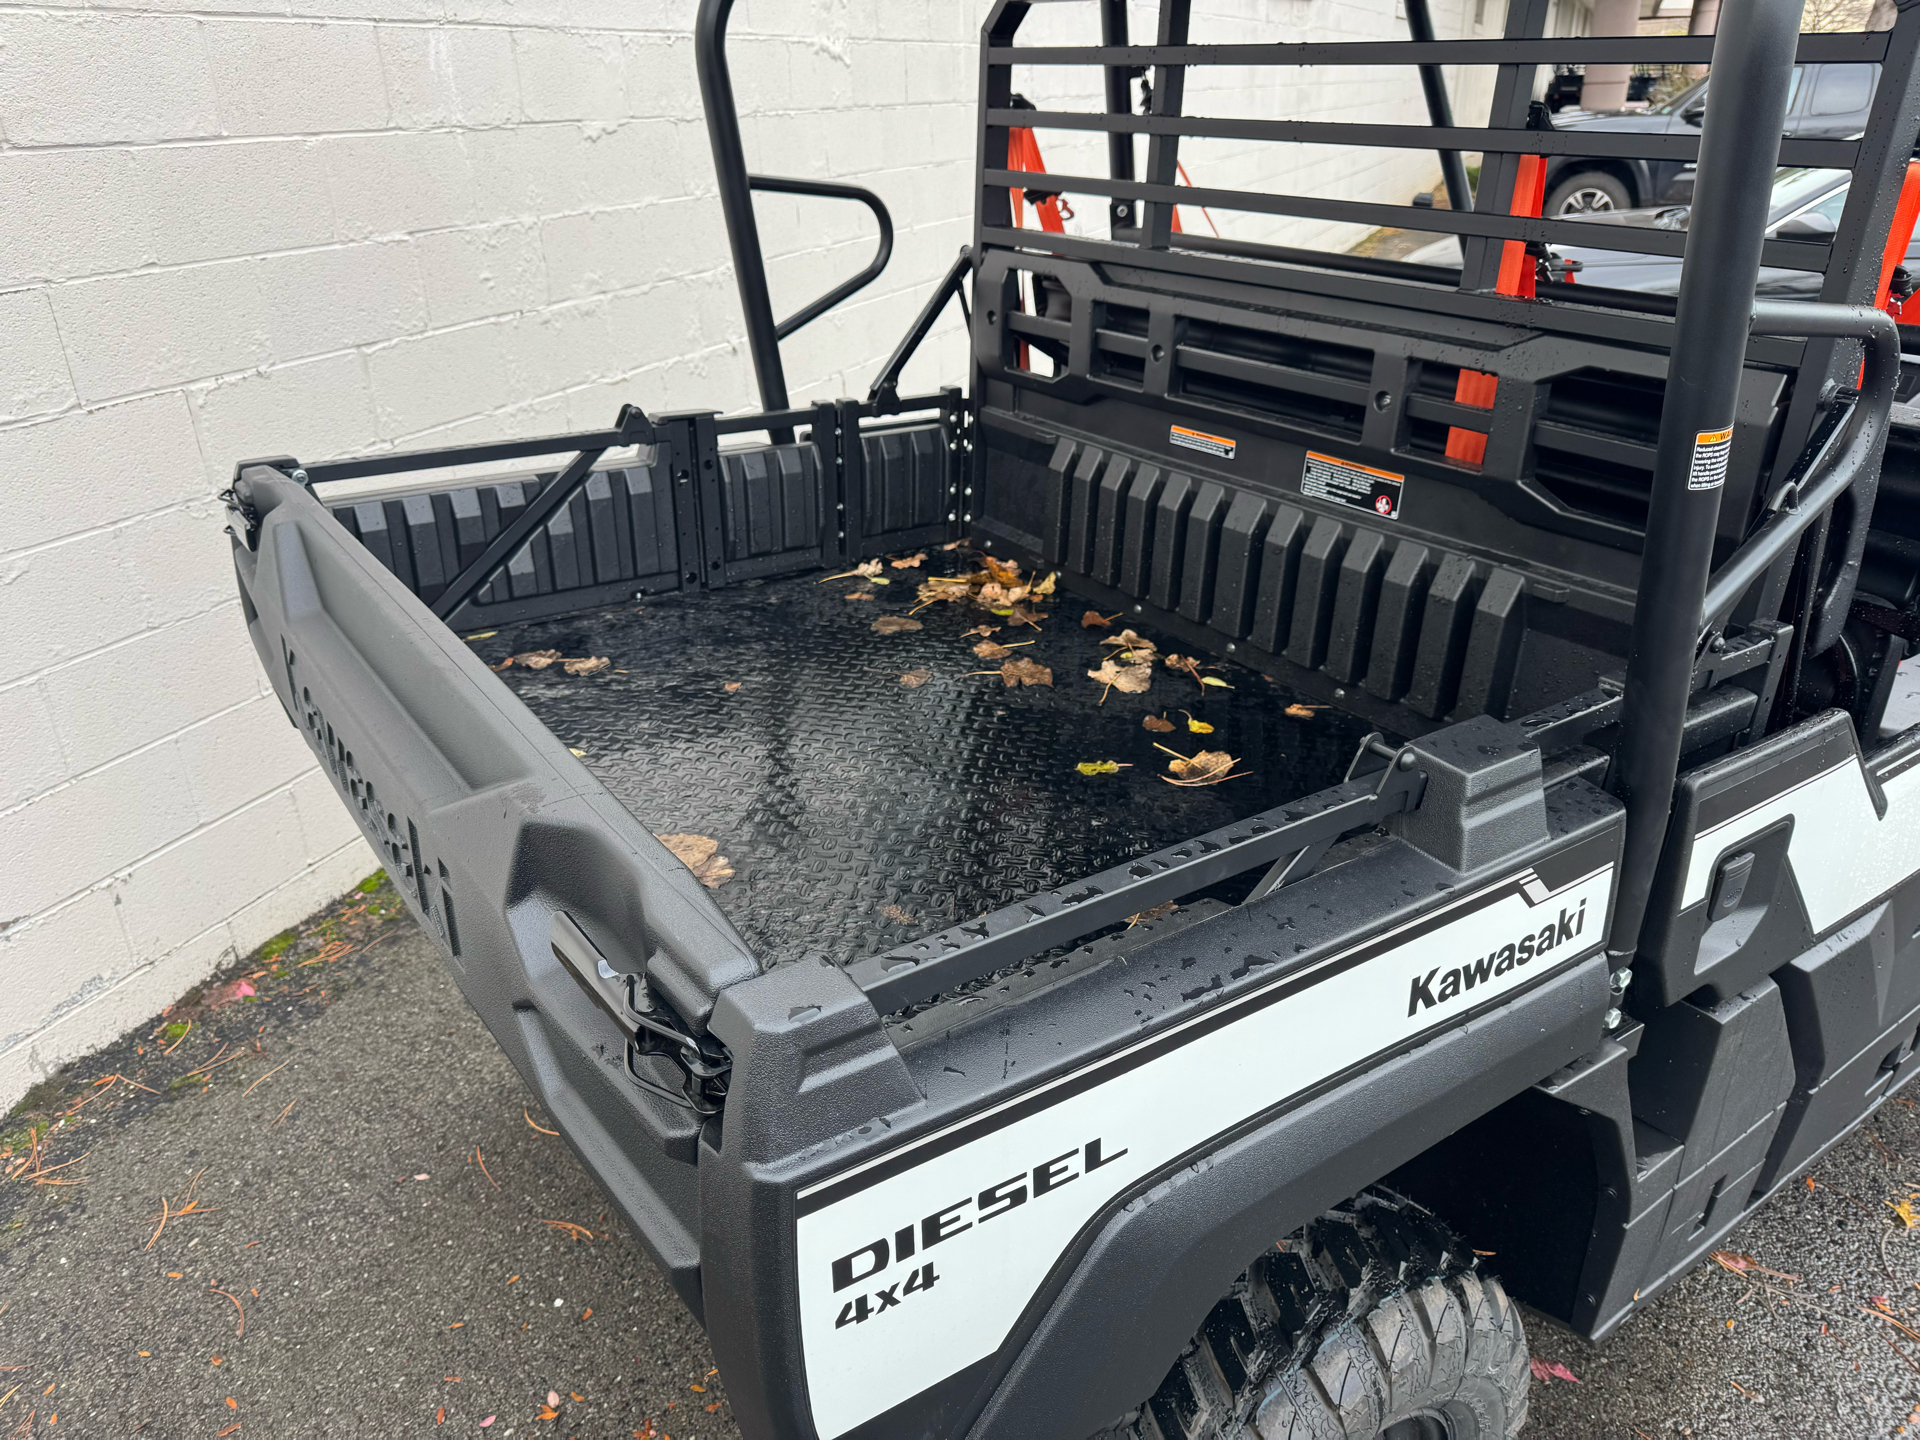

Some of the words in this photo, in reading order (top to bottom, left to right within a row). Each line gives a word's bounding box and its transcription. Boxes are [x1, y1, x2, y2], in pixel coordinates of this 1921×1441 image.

[1407, 897, 1587, 1018] Kawasaki
[831, 1137, 1129, 1293] DIESEL
[835, 1261, 940, 1330] 4x4
